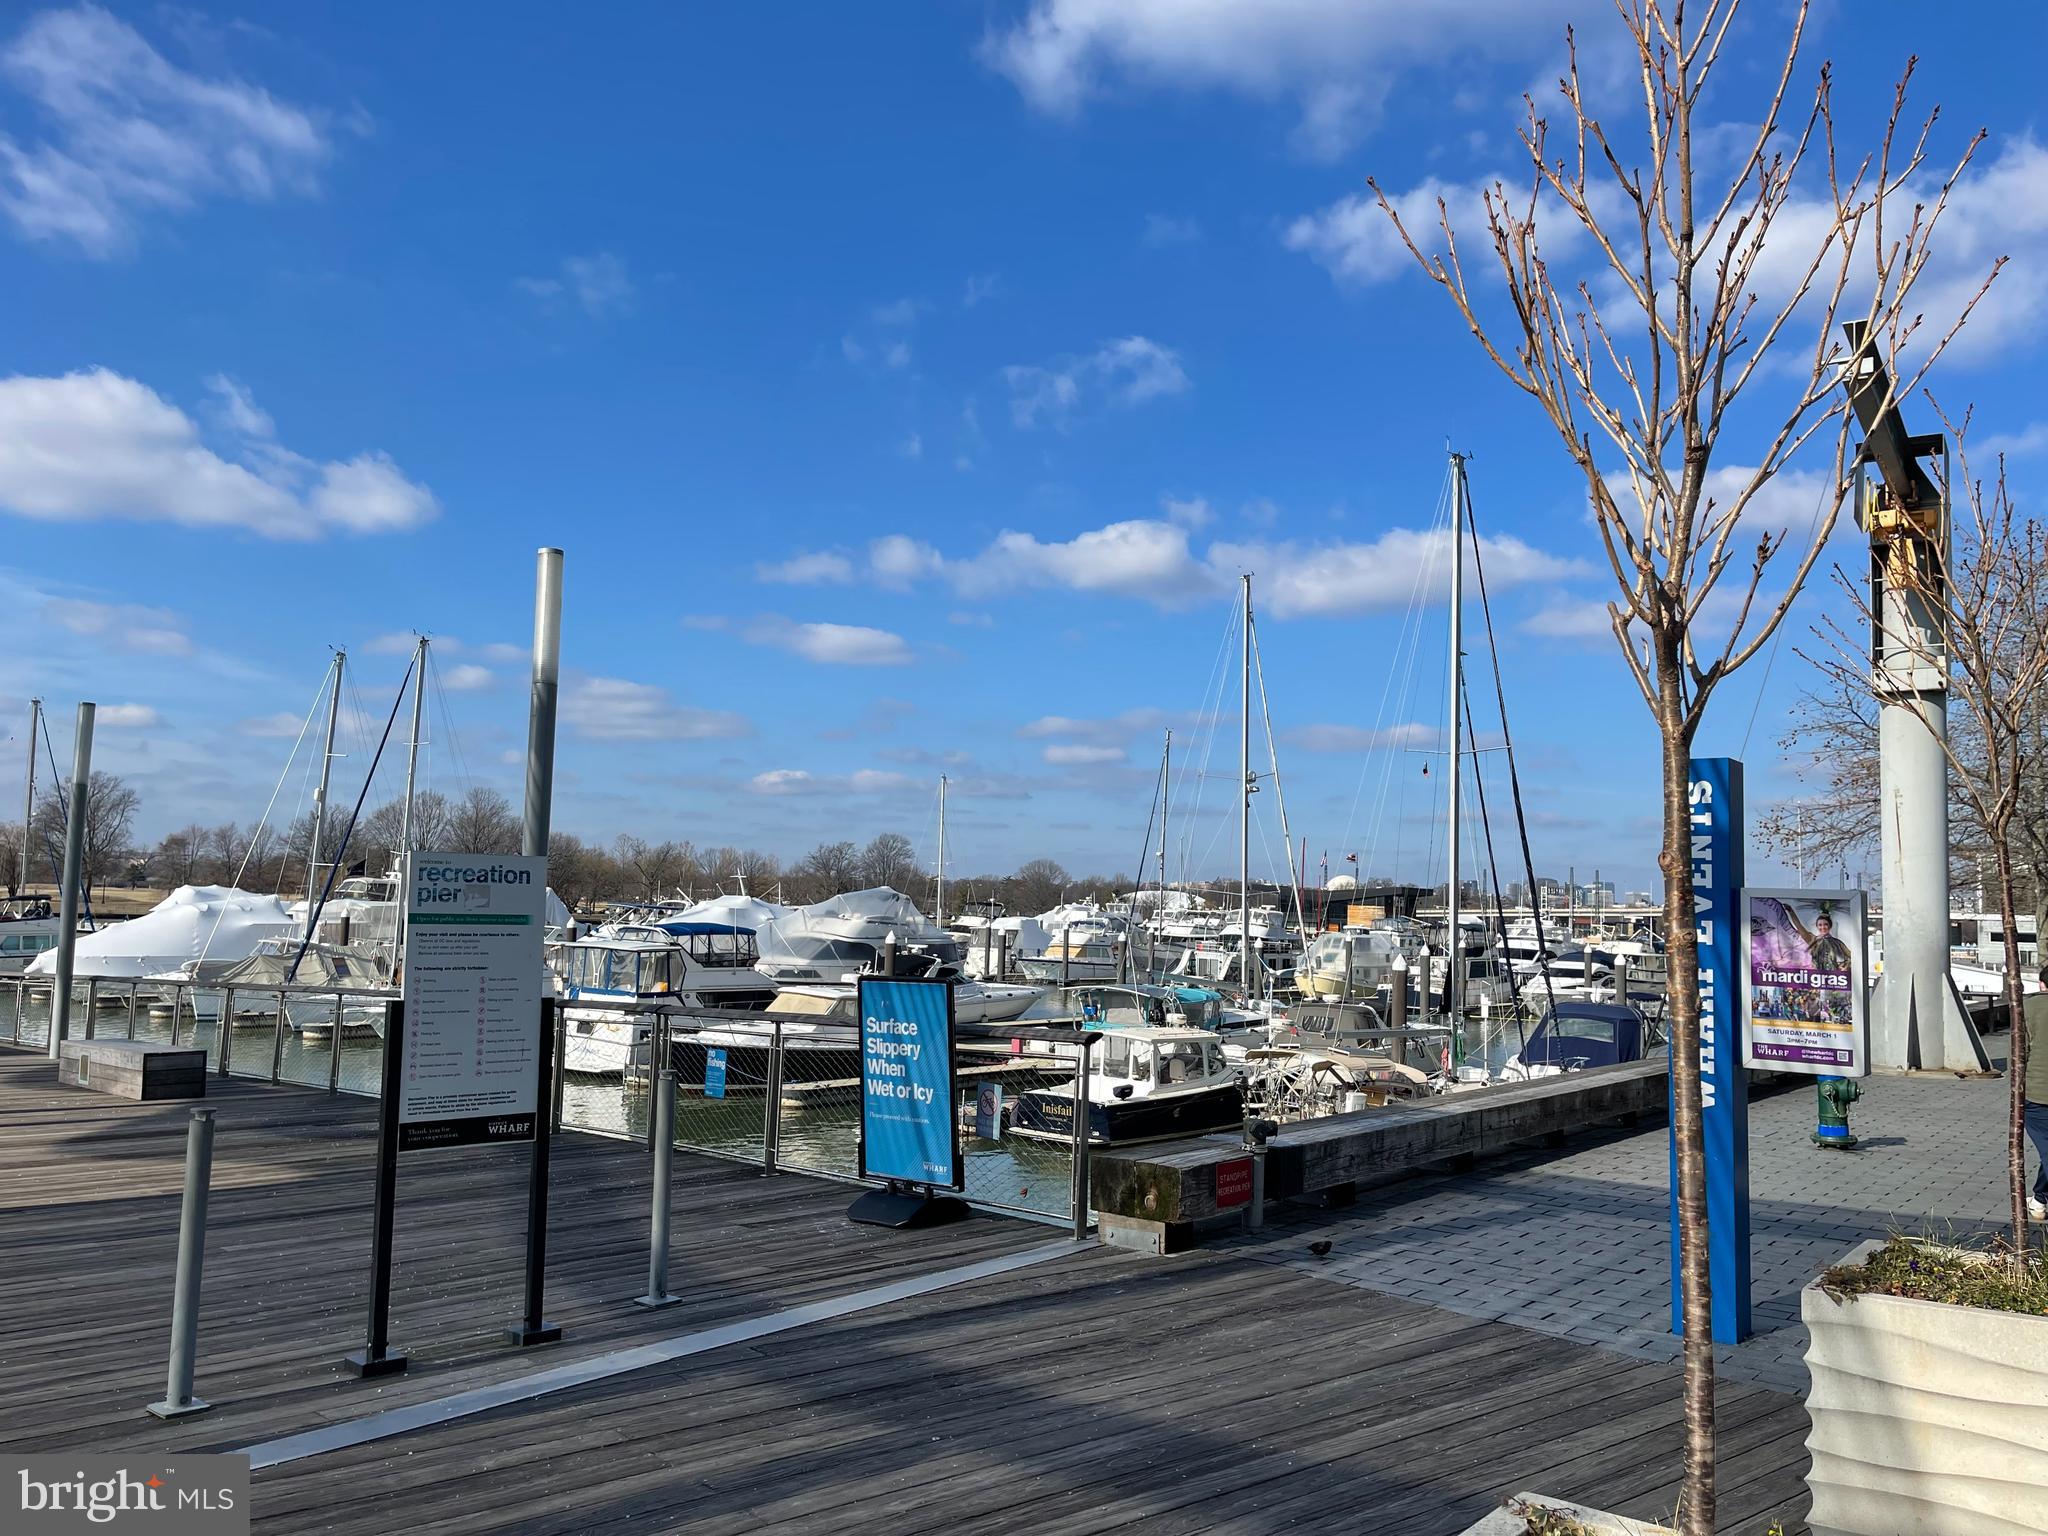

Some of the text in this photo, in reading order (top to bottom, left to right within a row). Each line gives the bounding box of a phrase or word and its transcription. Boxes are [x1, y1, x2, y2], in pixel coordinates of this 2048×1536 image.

[418, 865, 531, 885] recreation
[417, 883, 462, 908] pier
[1762, 970, 1848, 987] mardi gras
[866, 1016, 918, 1036] Surface
[1806, 1031, 1832, 1039] MARCH
[867, 1037, 921, 1061] Slippery
[1757, 1048, 1789, 1057] WHARF
[707, 1057, 726, 1071] fishing
[867, 1058, 906, 1077] When
[867, 1078, 934, 1105] Wet or Icy
[1042, 1103, 1073, 1117] Inisfail
[489, 1122, 530, 1134] WHARF
[923, 1163, 948, 1173] WHARF
